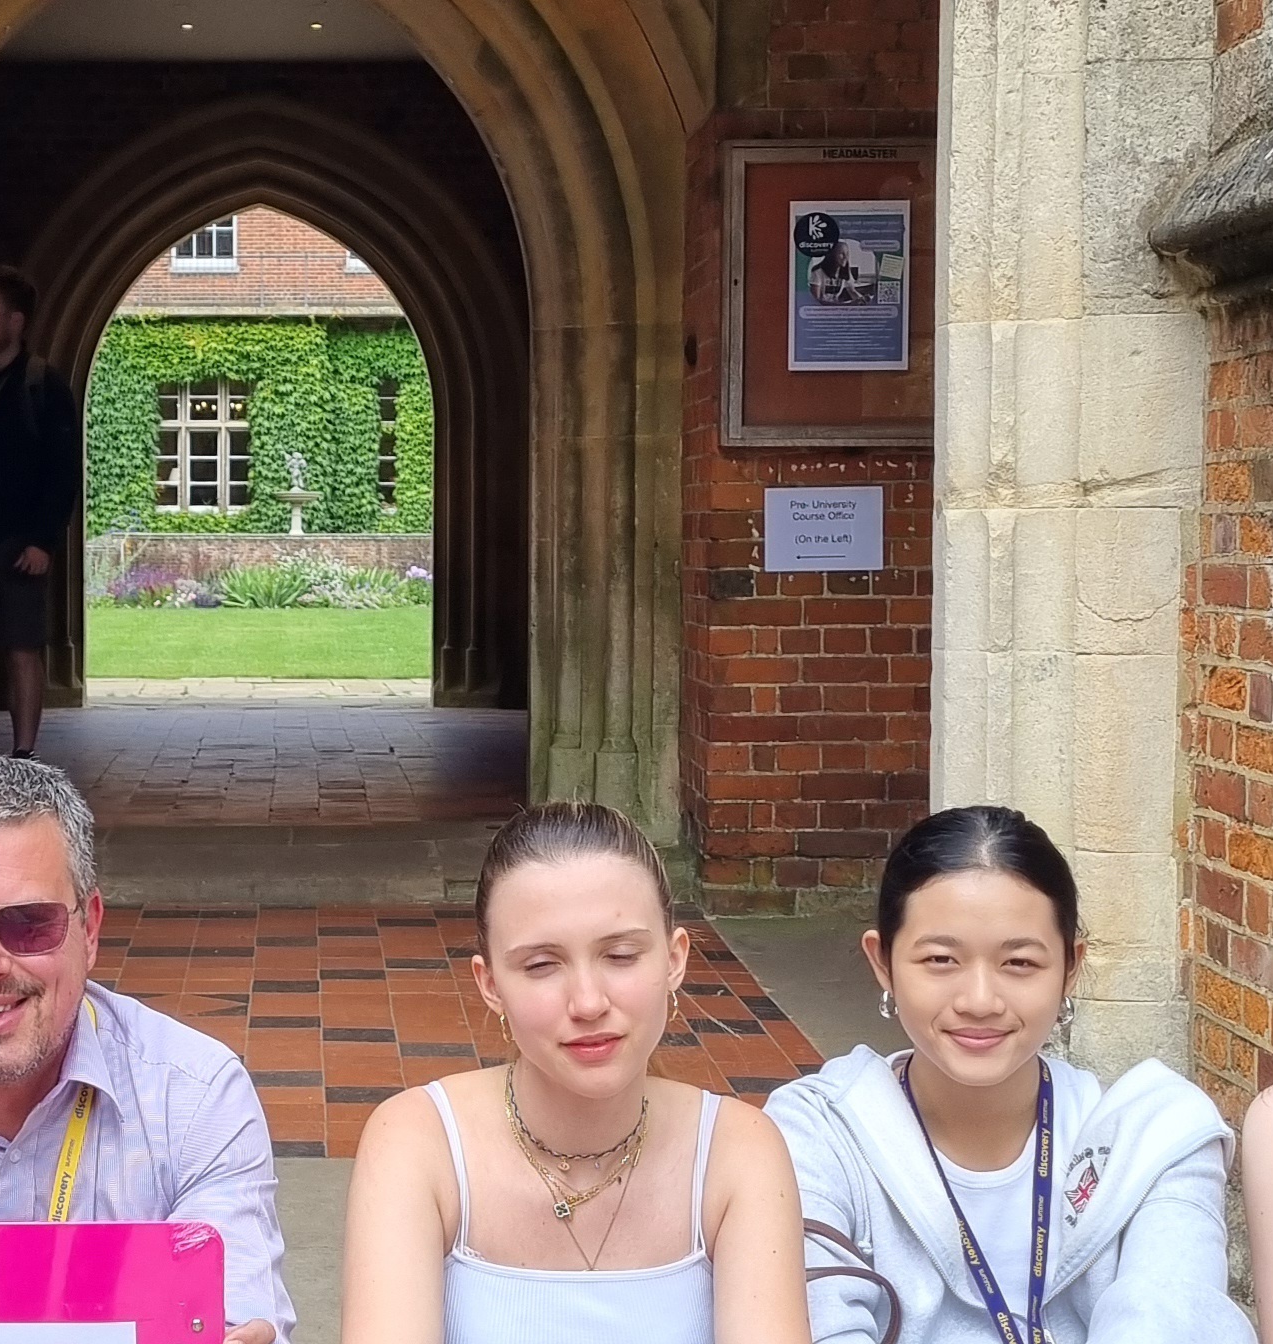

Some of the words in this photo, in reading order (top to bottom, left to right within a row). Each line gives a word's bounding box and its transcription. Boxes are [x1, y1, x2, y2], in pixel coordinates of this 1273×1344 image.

[823, 149, 897, 159] HEADMASTER
[798, 241, 833, 249] discovery
[812, 500, 857, 510] University
[792, 512, 825, 521] Course
[828, 511, 855, 520] Office
[795, 534, 812, 544] (On
[815, 535, 828, 543] the
[831, 534, 853, 544] Left)
[1038, 1127, 1051, 1178] discovery
[1033, 1225, 1047, 1278] discovery
